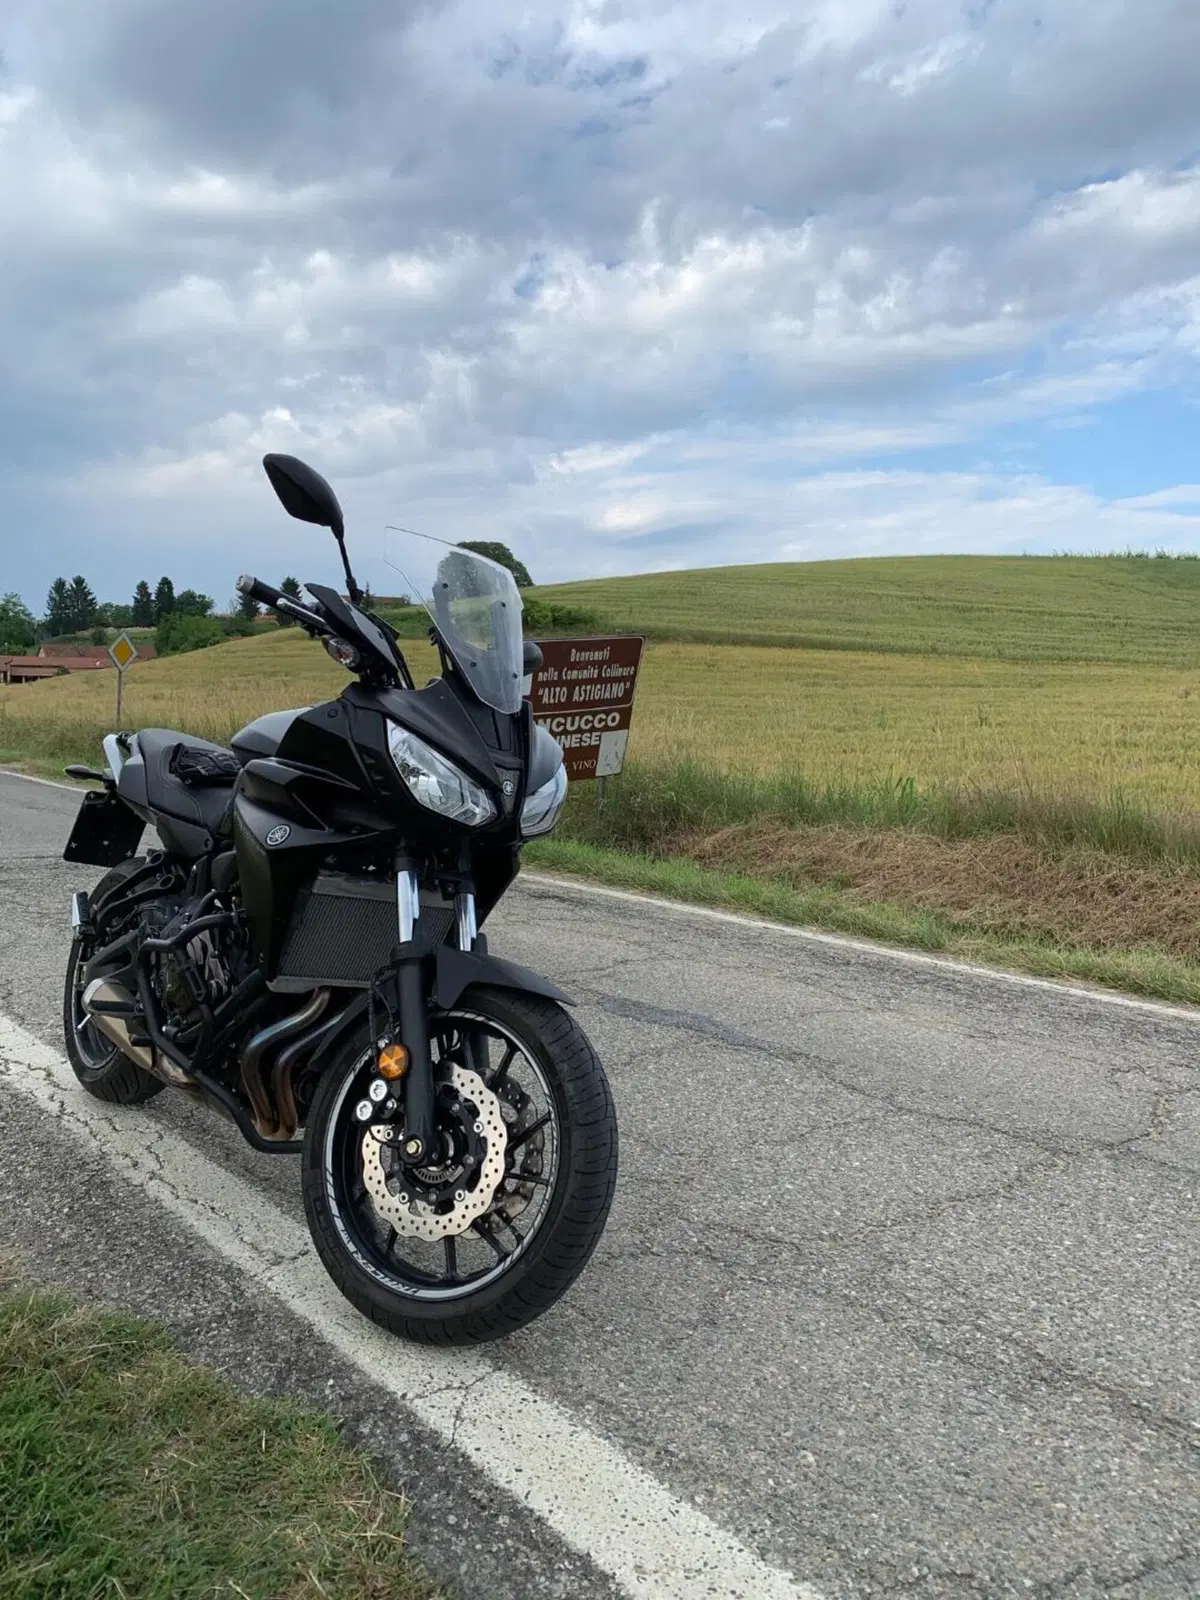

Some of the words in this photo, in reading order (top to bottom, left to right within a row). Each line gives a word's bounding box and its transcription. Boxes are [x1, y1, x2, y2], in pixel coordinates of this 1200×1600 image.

[570, 646, 611, 662] Benvenuti
[537, 667, 559, 681] nella
[562, 665, 599, 680] Comunità
[601, 664, 635, 677] Collinare
[537, 712, 620, 732] NCUCCO
[556, 732, 600, 749] INESE
[572, 759, 597, 771] VINO
